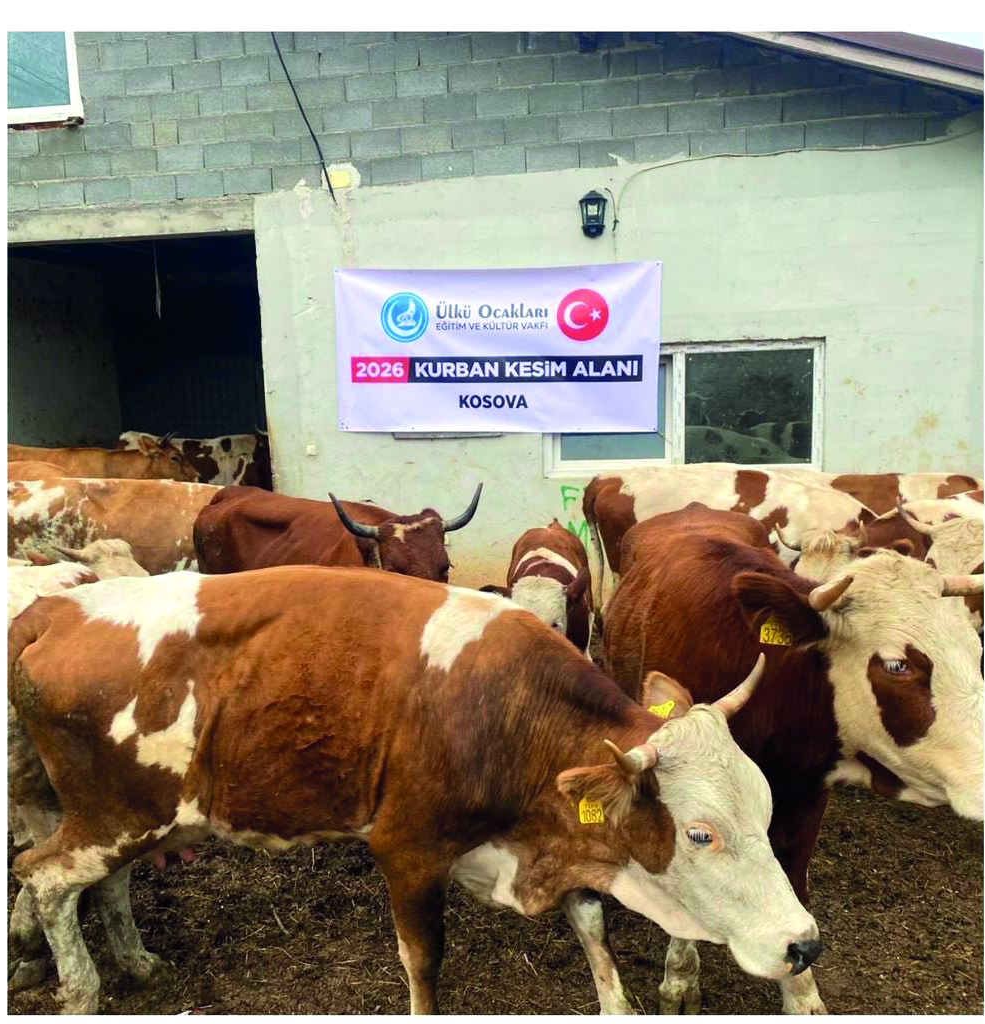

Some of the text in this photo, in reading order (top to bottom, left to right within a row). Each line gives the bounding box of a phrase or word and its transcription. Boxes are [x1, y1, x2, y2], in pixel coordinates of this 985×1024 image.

[436, 301, 471, 319] Ülkü
[436, 320, 548, 331] EĞİTİM VE KÜLTÜR VAKFI
[356, 361, 405, 378] 2026
[415, 361, 500, 378] KURBAN
[572, 360, 639, 378] ALANI
[459, 394, 529, 409] KOSOVA
